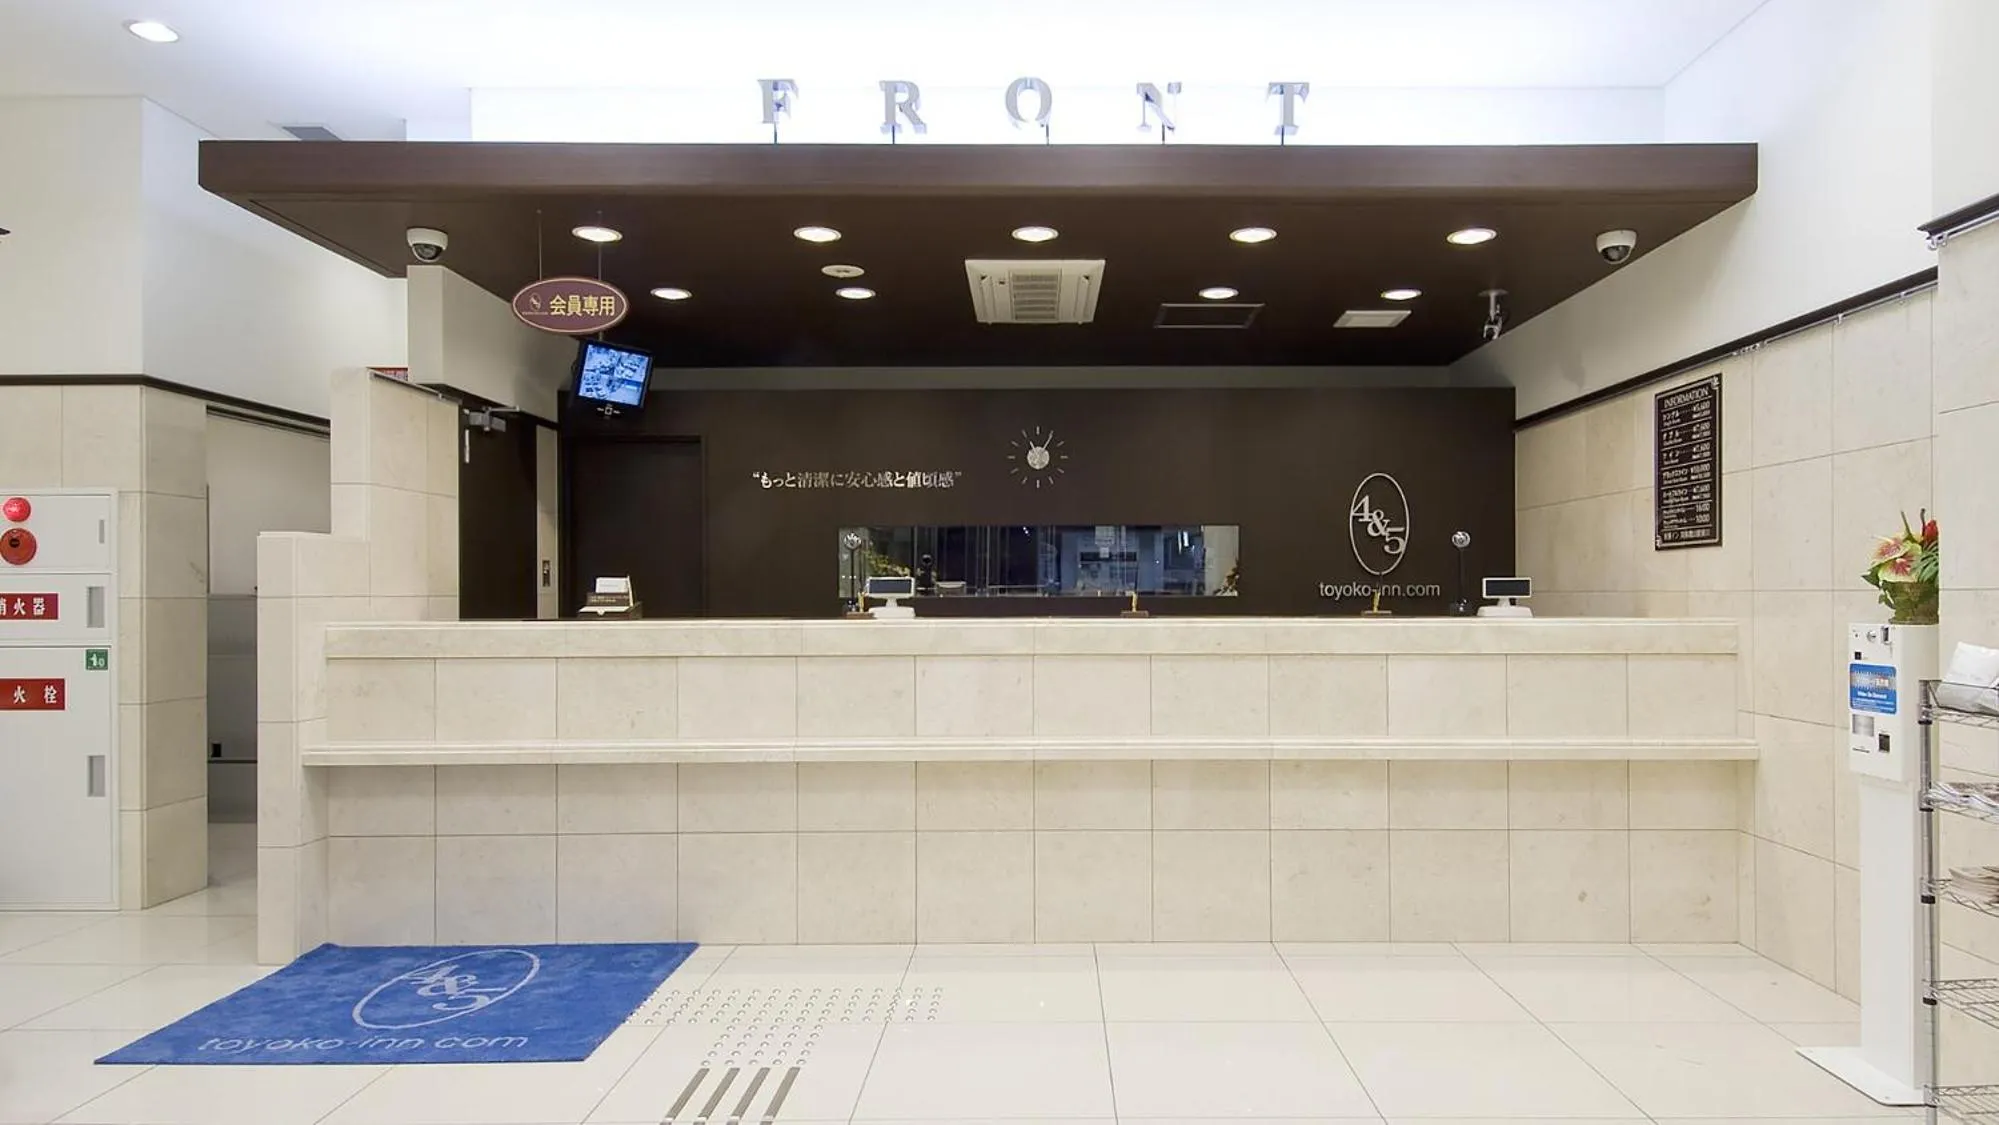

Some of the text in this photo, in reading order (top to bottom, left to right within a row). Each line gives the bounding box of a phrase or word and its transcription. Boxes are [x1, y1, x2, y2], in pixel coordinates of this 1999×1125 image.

[757, 77, 1310, 134] FRONT
[550, 293, 616, 316] 会員専用
[1664, 387, 1708, 407] INFORMATION
[1352, 494, 1406, 555] 4&5
